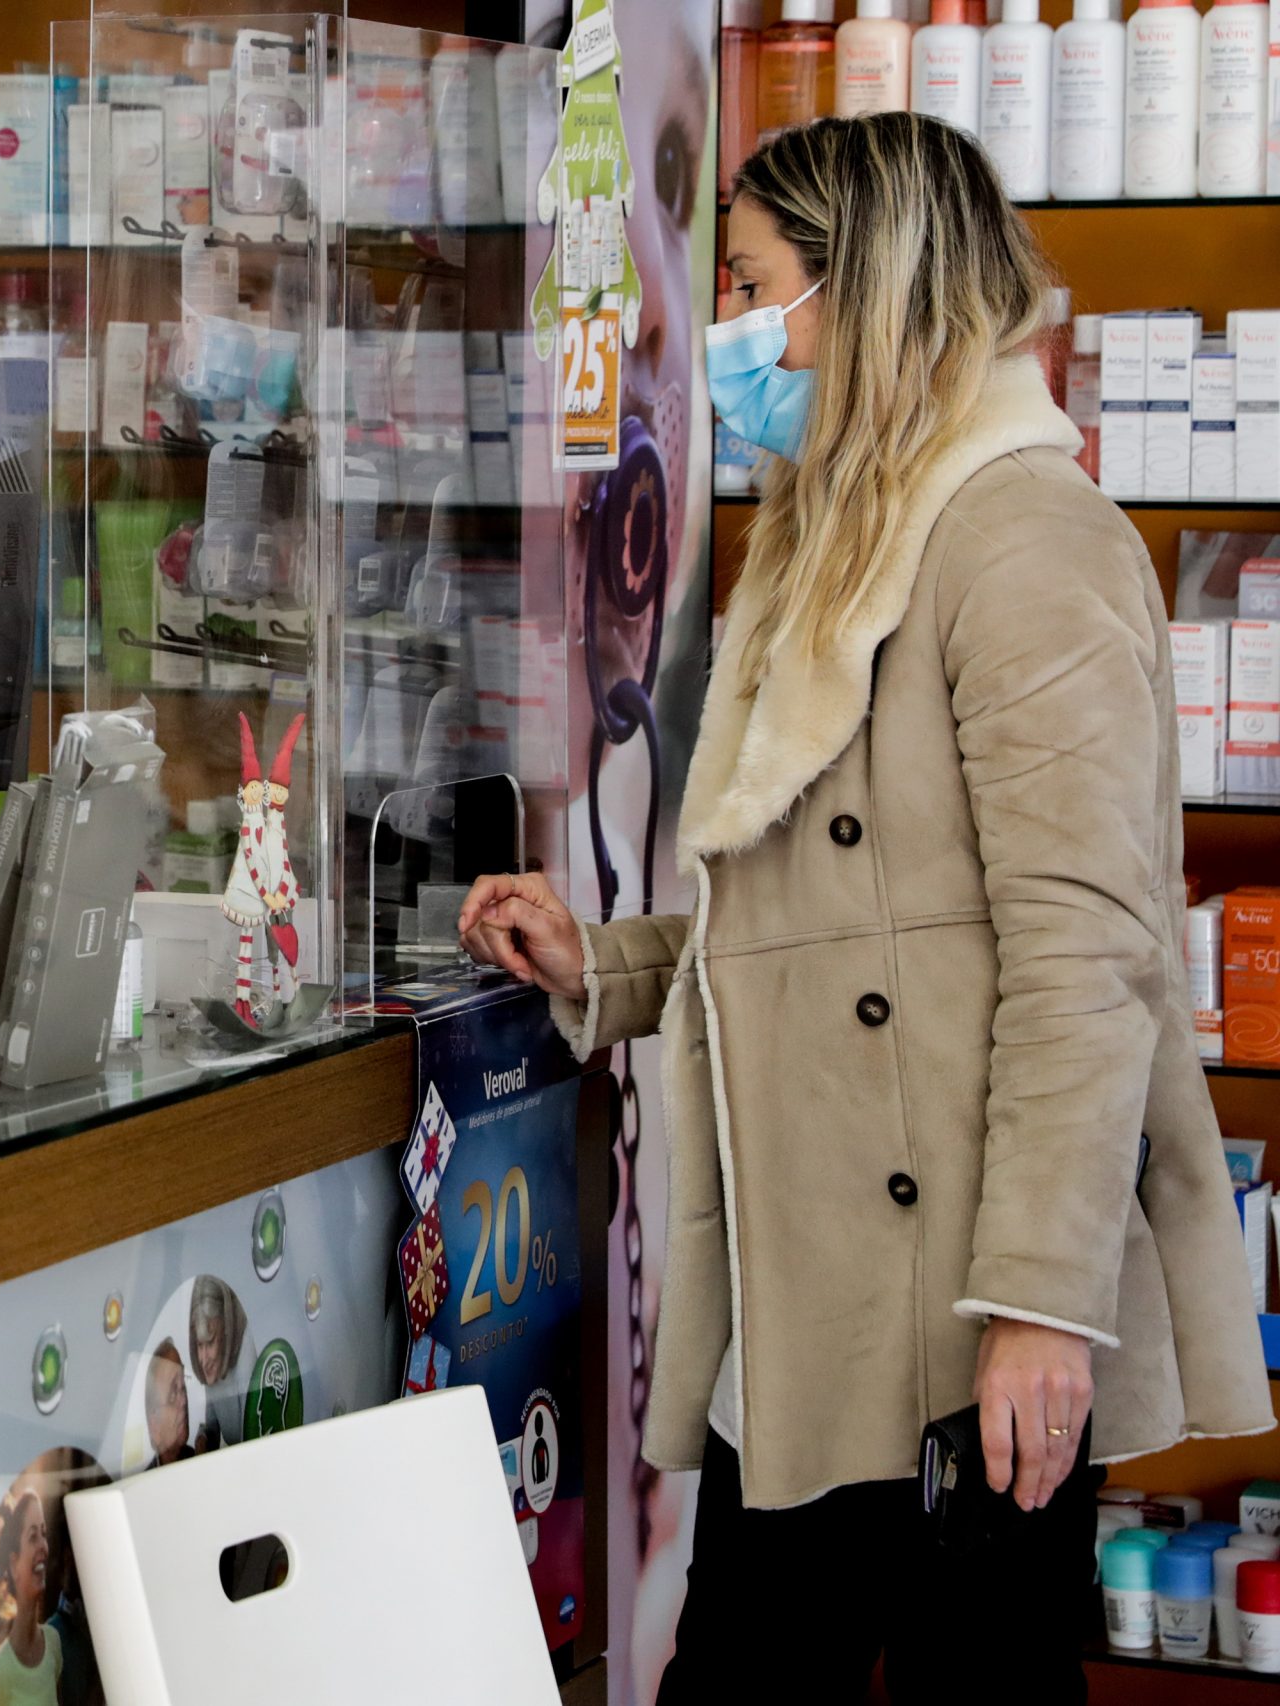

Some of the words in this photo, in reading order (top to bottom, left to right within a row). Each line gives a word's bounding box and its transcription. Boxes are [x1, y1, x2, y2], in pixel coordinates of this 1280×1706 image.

[1135, 26, 1174, 42] Avène
[1211, 26, 1253, 41] Avène
[1234, 911, 1273, 925] Avène
[483, 1057, 528, 1100] Veroval
[460, 1166, 557, 1325] 20%
